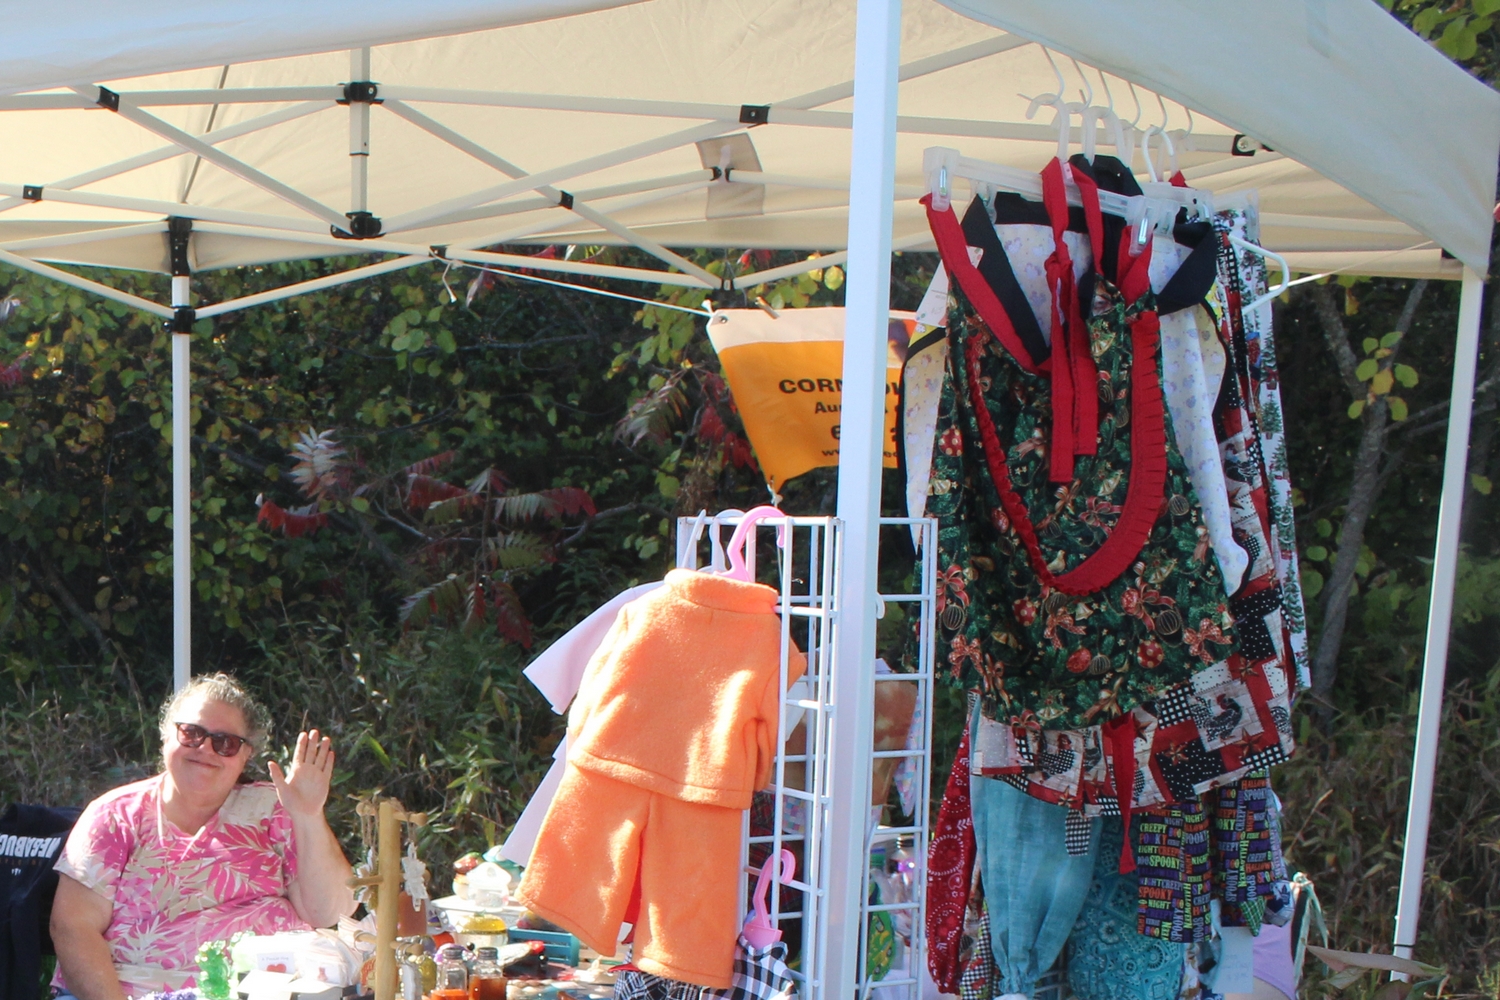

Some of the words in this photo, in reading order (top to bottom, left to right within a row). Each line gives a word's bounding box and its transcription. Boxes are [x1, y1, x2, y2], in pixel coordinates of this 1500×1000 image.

[1140, 823, 1168, 834] CREEPY
[1149, 854, 1180, 871] SPOOKY
[1138, 886, 1174, 900] SPOOKY
[1148, 899, 1171, 910] NIGHT
